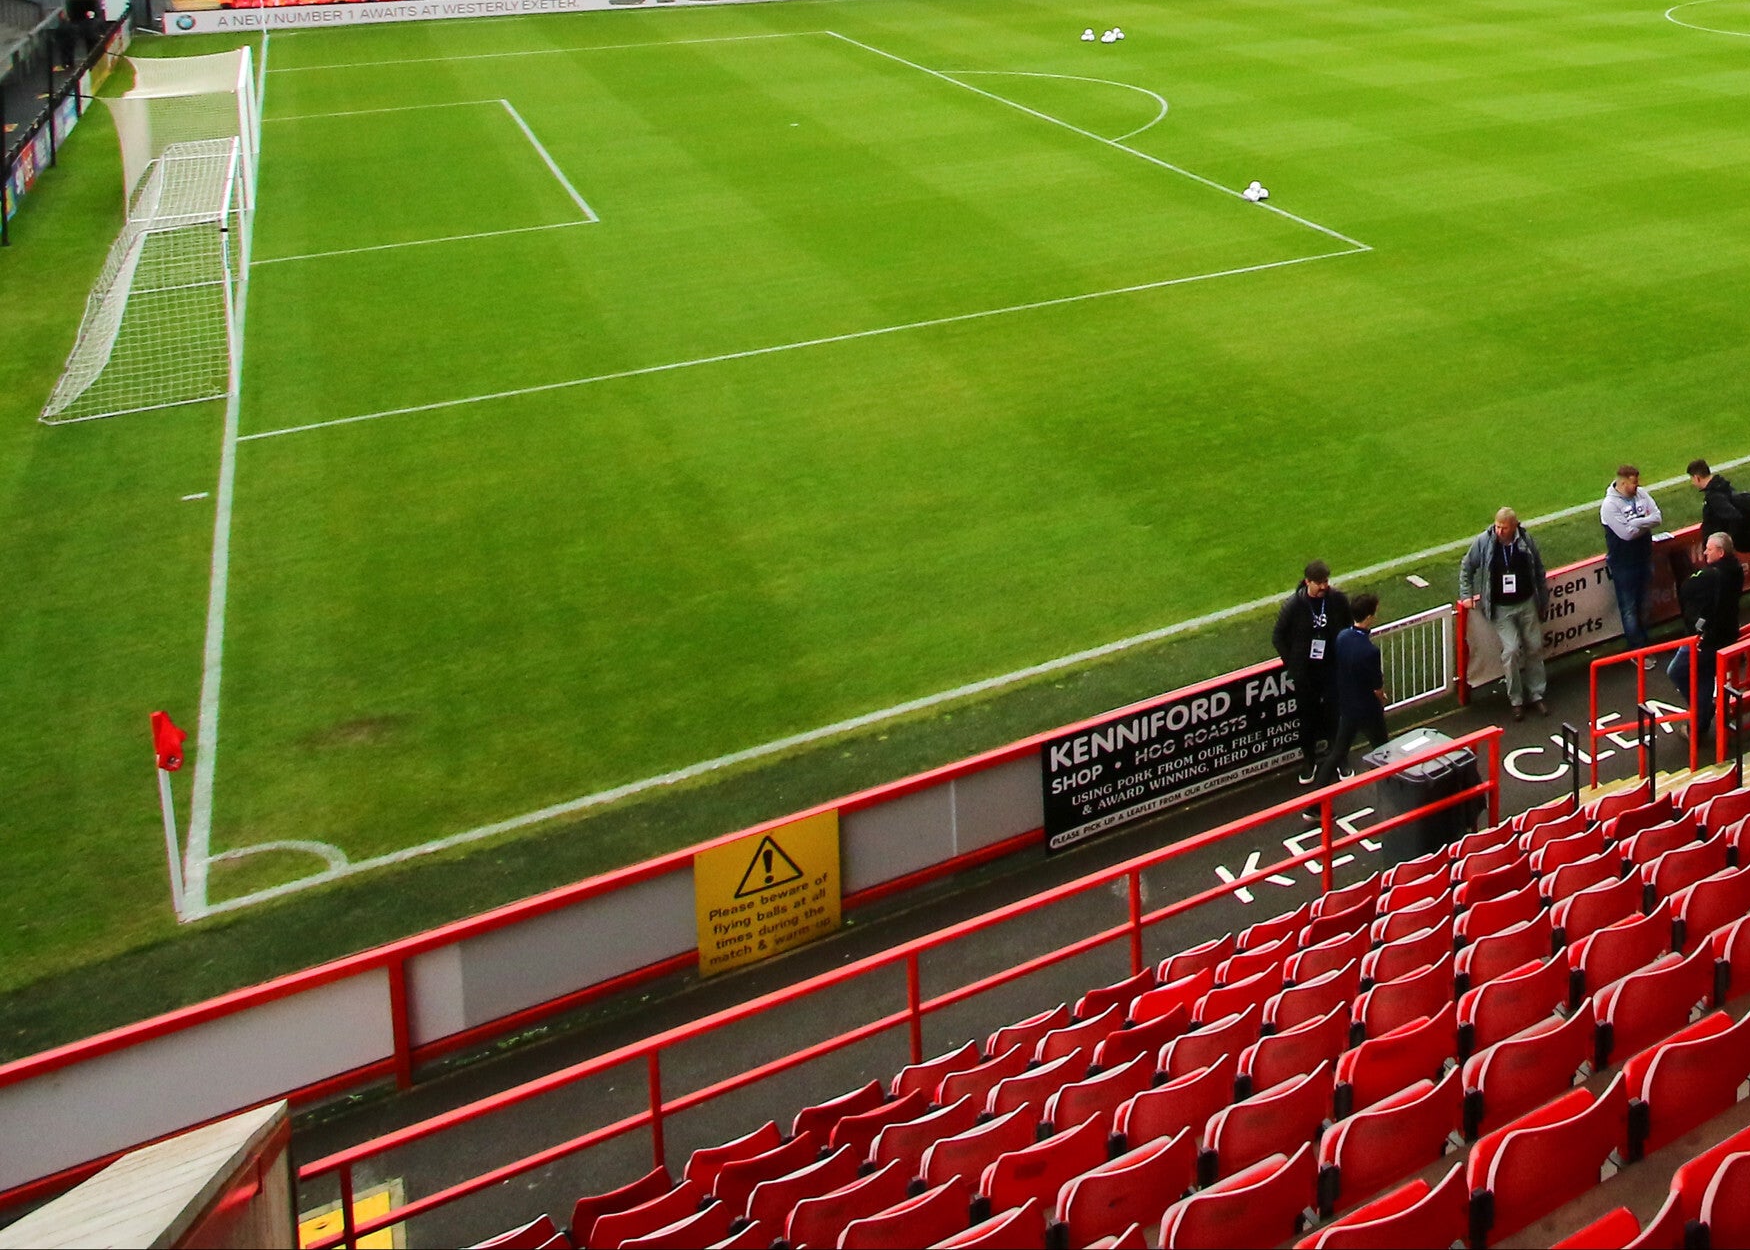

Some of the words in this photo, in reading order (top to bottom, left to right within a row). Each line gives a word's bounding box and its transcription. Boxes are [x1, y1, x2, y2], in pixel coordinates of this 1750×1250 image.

[217, 15, 229, 27] A
[233, 13, 267, 26] NEW
[274, 10, 343, 24] NUMBER
[349, 10, 355, 20] 1
[360, 6, 417, 19] AWAITS
[421, 4, 439, 16] AT
[442, 0, 520, 15] WESTERLY
[1543, 617, 1604, 648] Sports
[1050, 691, 1231, 773] KENNIFORD
[1051, 764, 1103, 795] SHOP
[1134, 739, 1176, 766] HOG
[1184, 715, 1248, 749] ROASTS
[1071, 783, 1113, 806] USING
[1117, 769, 1153, 790] PORK
[1157, 754, 1194, 775] FROM
[1231, 730, 1262, 749] FREE
[1081, 804, 1093, 816] &
[1097, 785, 1145, 810] AWARD
[1214, 750, 1248, 769] HERD
[1252, 741, 1268, 754] OF
[1272, 731, 1300, 748] PIGS
[1051, 828, 1081, 846] PLEASE
[1083, 820, 1102, 834] PICK
[1104, 816, 1115, 828] UP
[1118, 813, 1124, 821] A
[1126, 801, 1157, 818] LEAFLET
[1159, 793, 1182, 808] FROM
[1184, 785, 1200, 798] OUR
[1203, 772, 1239, 791] CATERING
[1242, 761, 1269, 777] TRAILER
[1271, 757, 1280, 767] IN
[709, 901, 755, 921] Please
[760, 882, 809, 905] beware
[815, 872, 828, 886] of
[713, 917, 752, 935] flying
[757, 905, 788, 921] balls
[793, 897, 806, 909] at
[812, 888, 826, 902] all
[710, 945, 752, 966] match
[758, 939, 768, 950] &
[774, 925, 810, 945] warm
[816, 917, 831, 929] up
[716, 932, 753, 949] times
[758, 916, 799, 936] during
[804, 906, 825, 919] the
